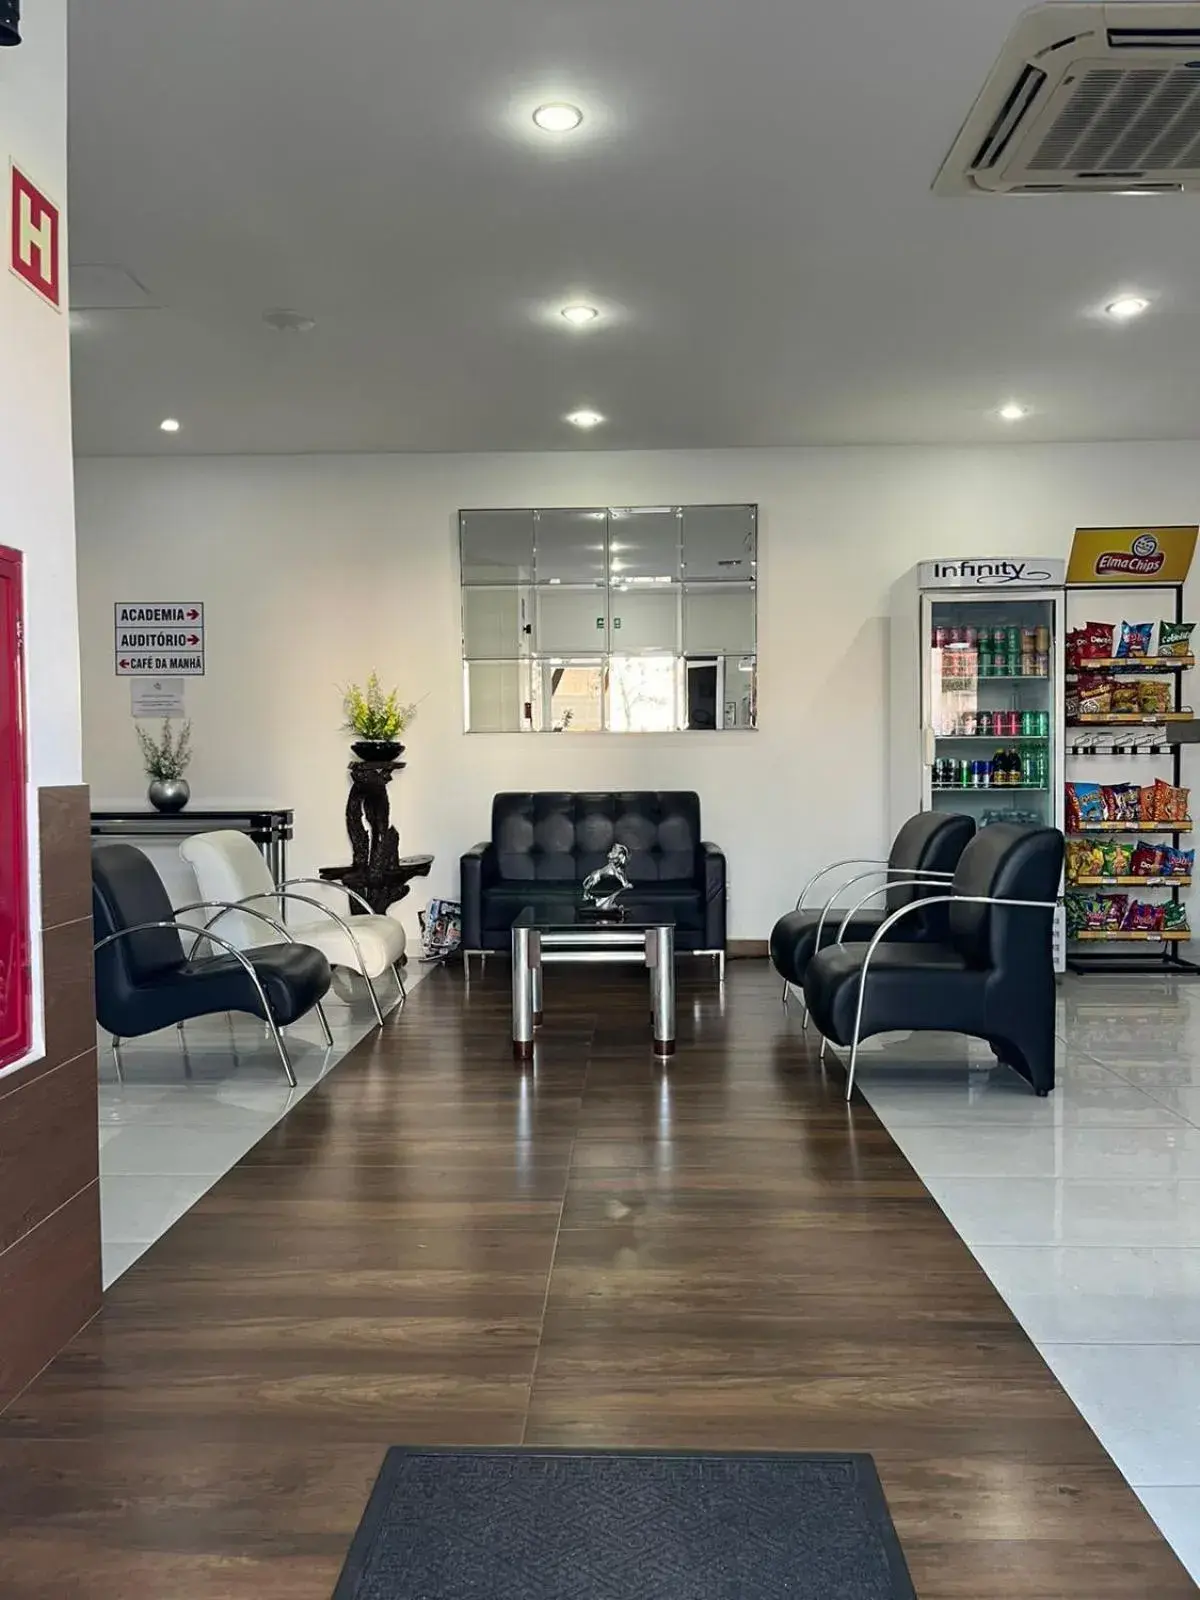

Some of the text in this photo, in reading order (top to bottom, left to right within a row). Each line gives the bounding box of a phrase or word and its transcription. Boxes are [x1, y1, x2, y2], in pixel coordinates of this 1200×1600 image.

[20, 188, 51, 285] H
[934, 560, 1042, 583] Infinity
[121, 608, 184, 621] ACADEMIA
[121, 631, 186, 646] AUDITÓRIO
[130, 656, 201, 669] CAFÉ DA MANHÃ
